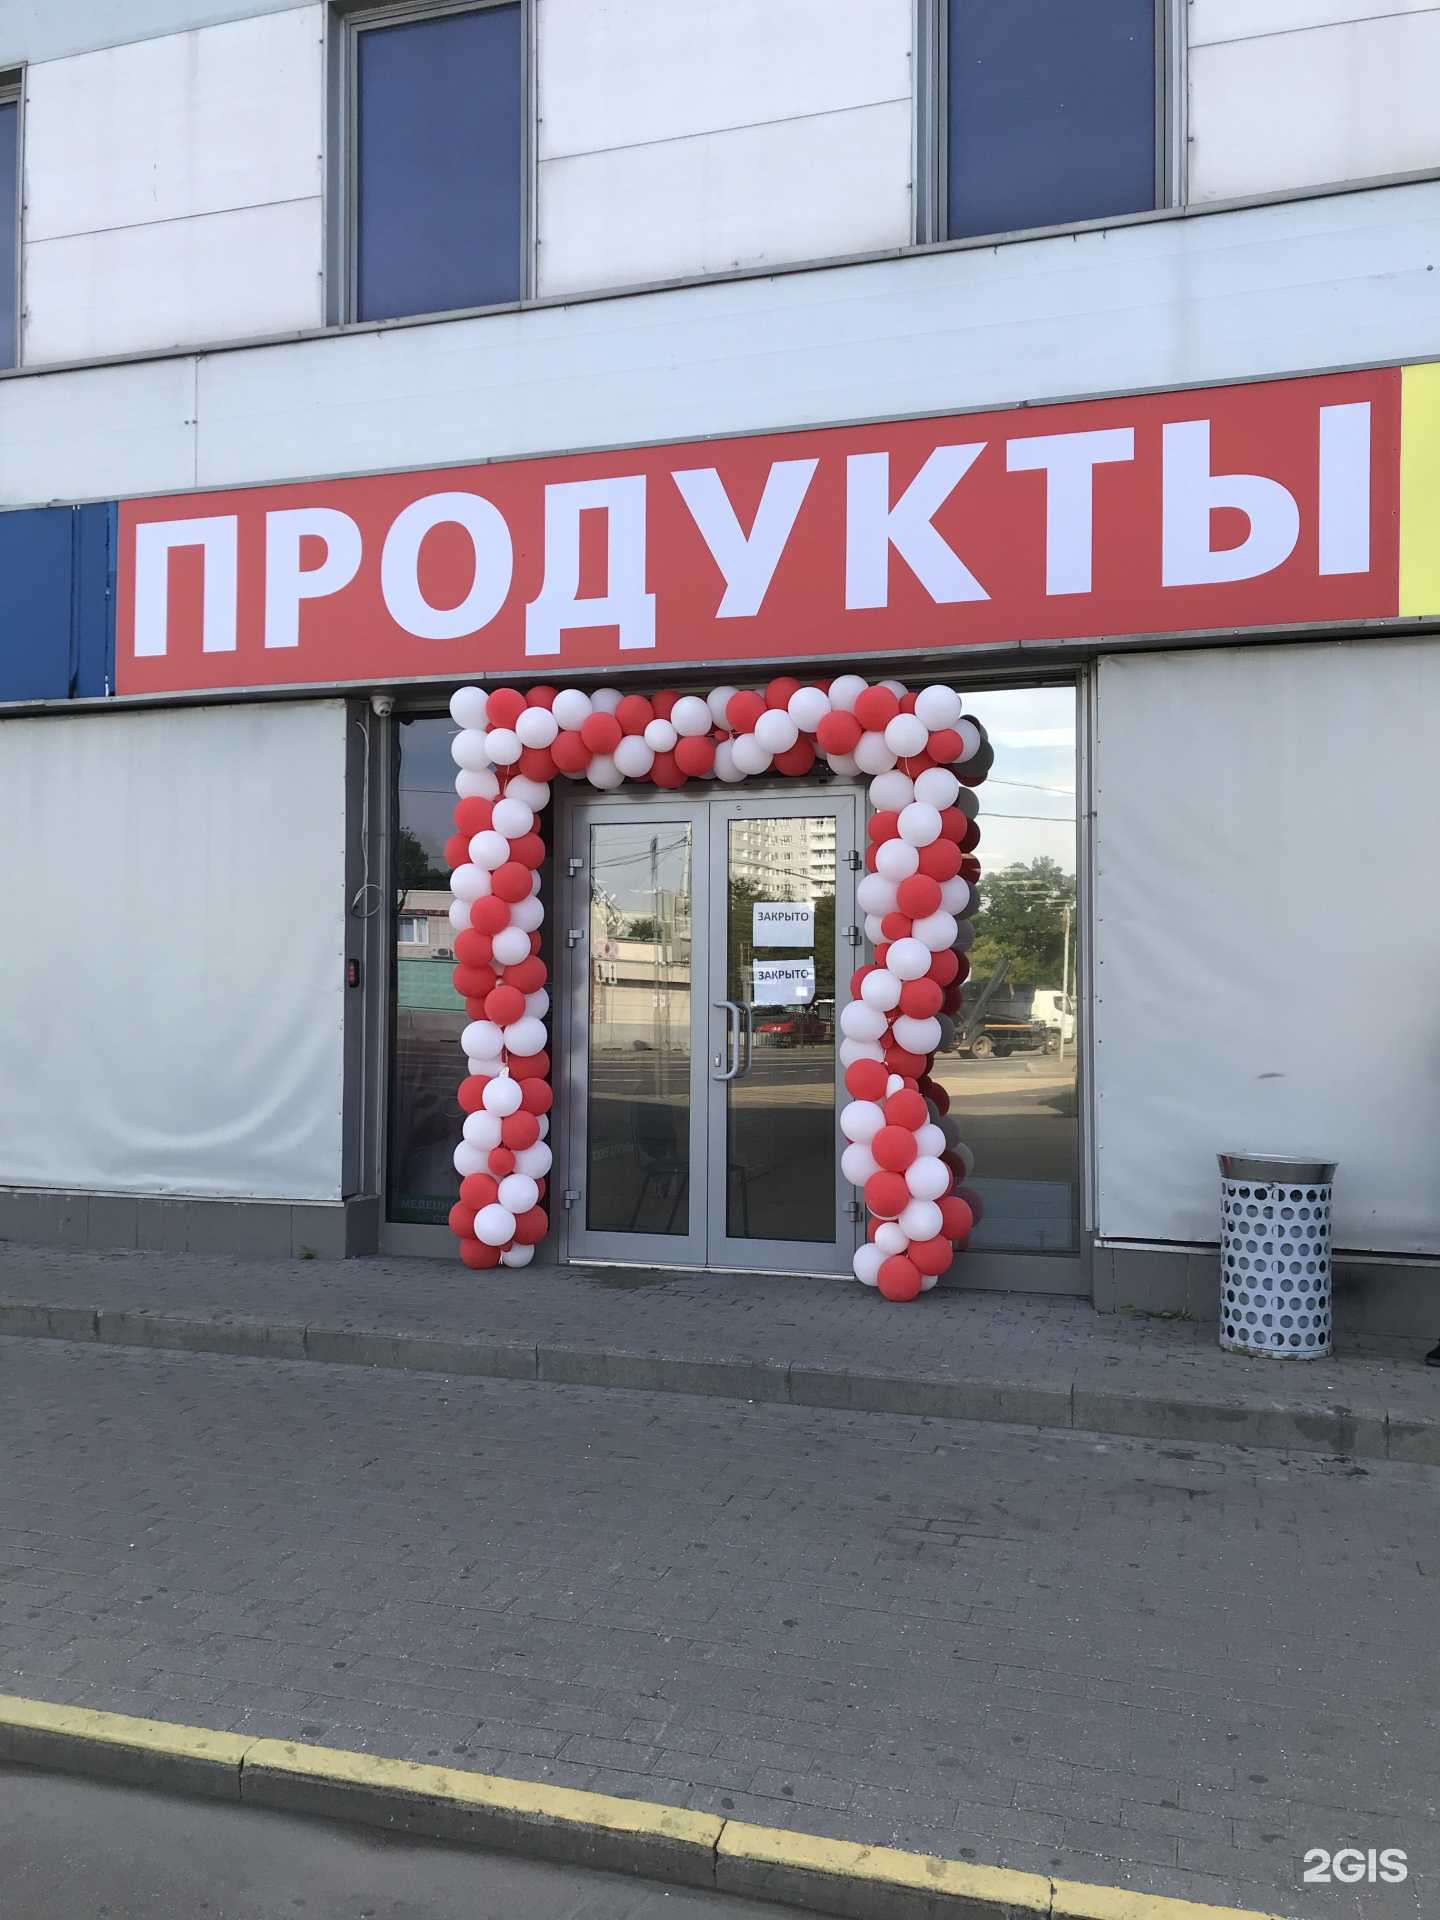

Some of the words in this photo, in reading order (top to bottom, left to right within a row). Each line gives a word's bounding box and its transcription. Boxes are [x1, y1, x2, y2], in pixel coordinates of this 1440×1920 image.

[134, 401, 1371, 657] ПРОДУКТЫ
[757, 912, 809, 922] ЗАКРЫТО
[758, 969, 809, 980] ЗАКРЫТО
